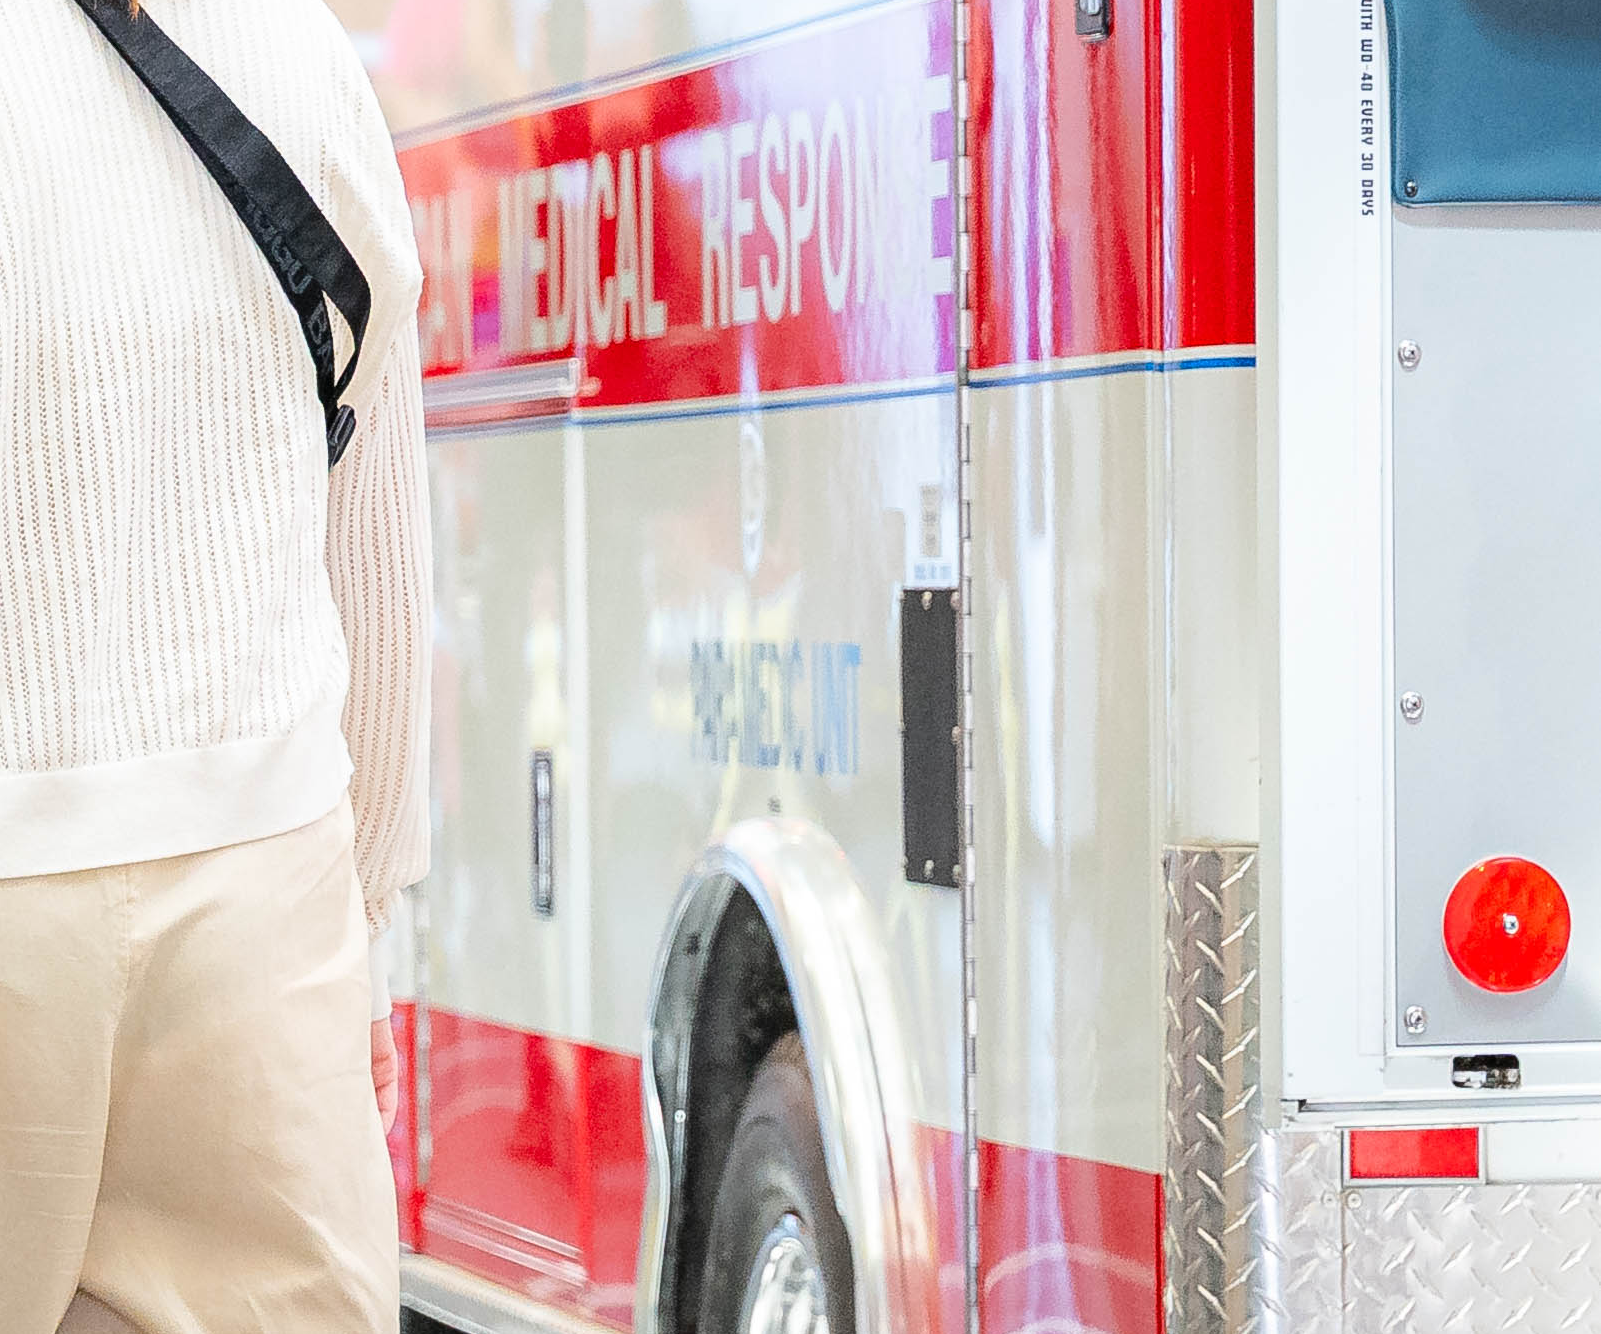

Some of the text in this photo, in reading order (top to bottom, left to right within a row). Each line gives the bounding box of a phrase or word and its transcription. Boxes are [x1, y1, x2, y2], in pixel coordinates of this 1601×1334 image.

[1360, 39, 1373, 91] WD-40
[1361, 99, 1374, 145] EVERY
[1361, 153, 1374, 171] 30
[499, 145, 668, 353] MEDICAL
[700, 74, 953, 331] RESPONE
[1361, 179, 1374, 216] DAYS
